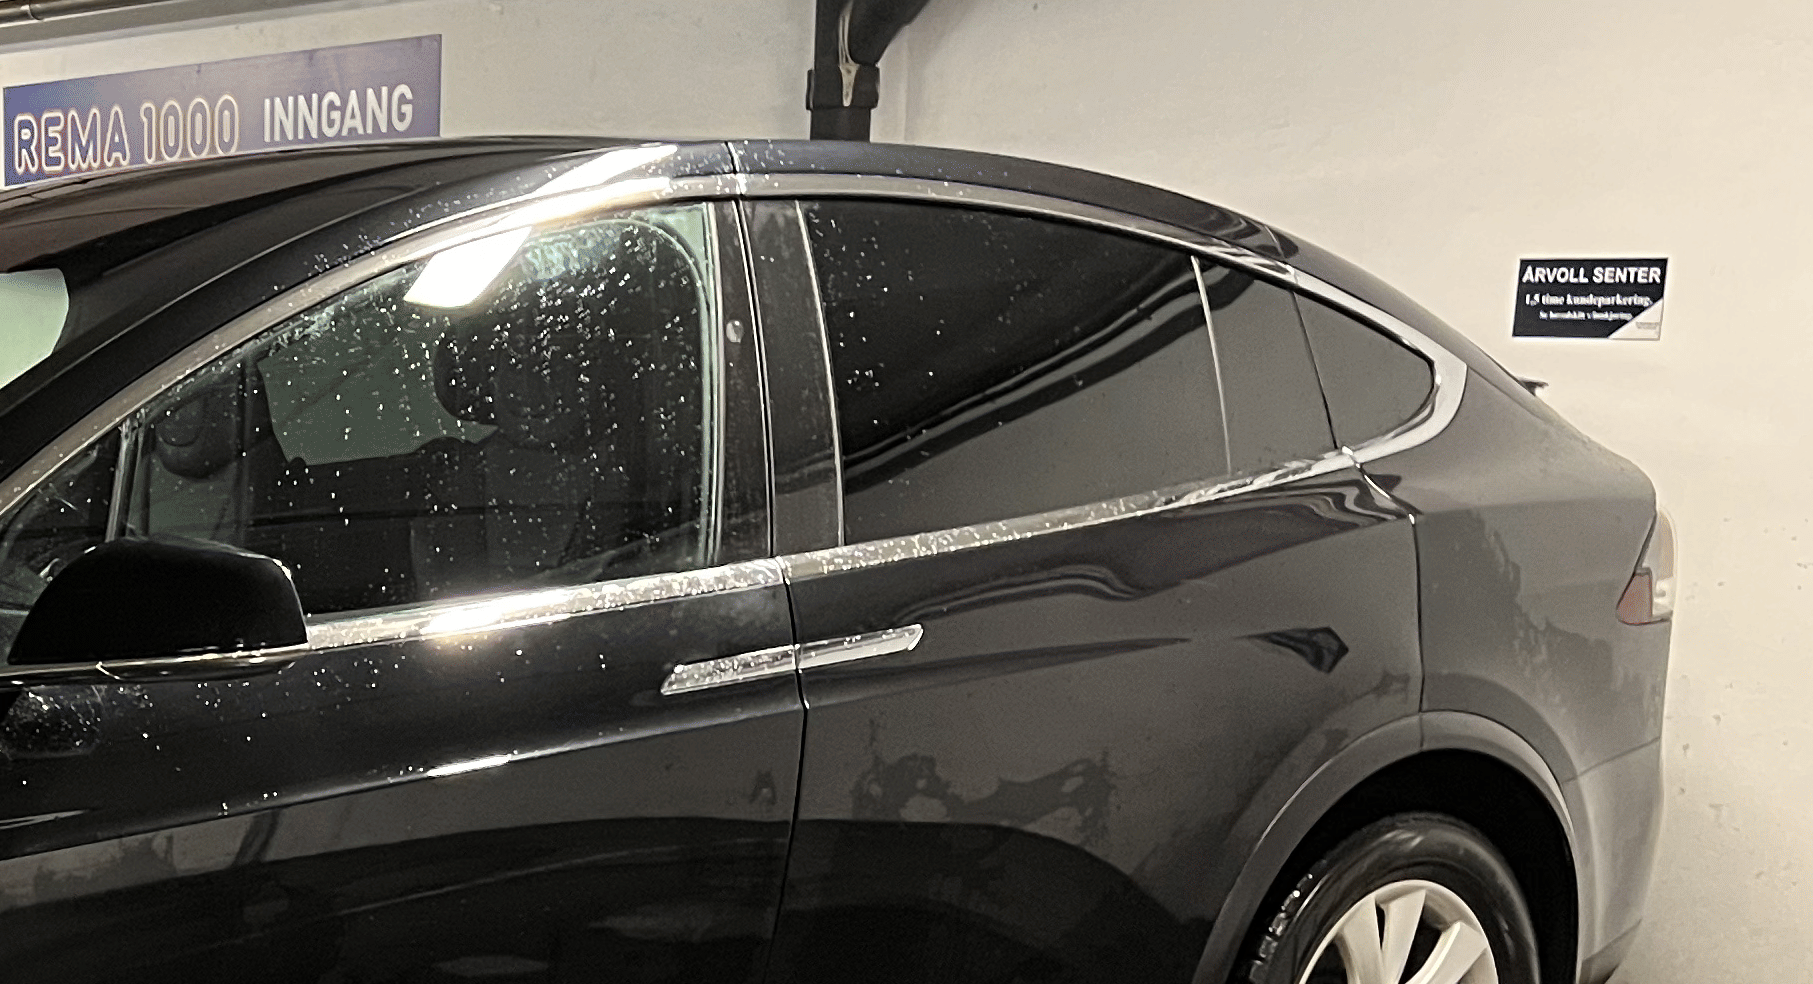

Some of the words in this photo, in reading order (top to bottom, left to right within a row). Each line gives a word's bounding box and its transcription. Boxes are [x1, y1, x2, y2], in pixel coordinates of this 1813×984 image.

[13, 104, 131, 176] REMA
[139, 94, 240, 166] 1000
[263, 84, 414, 143] INNGANG
[1592, 266, 1662, 284] SENTER
